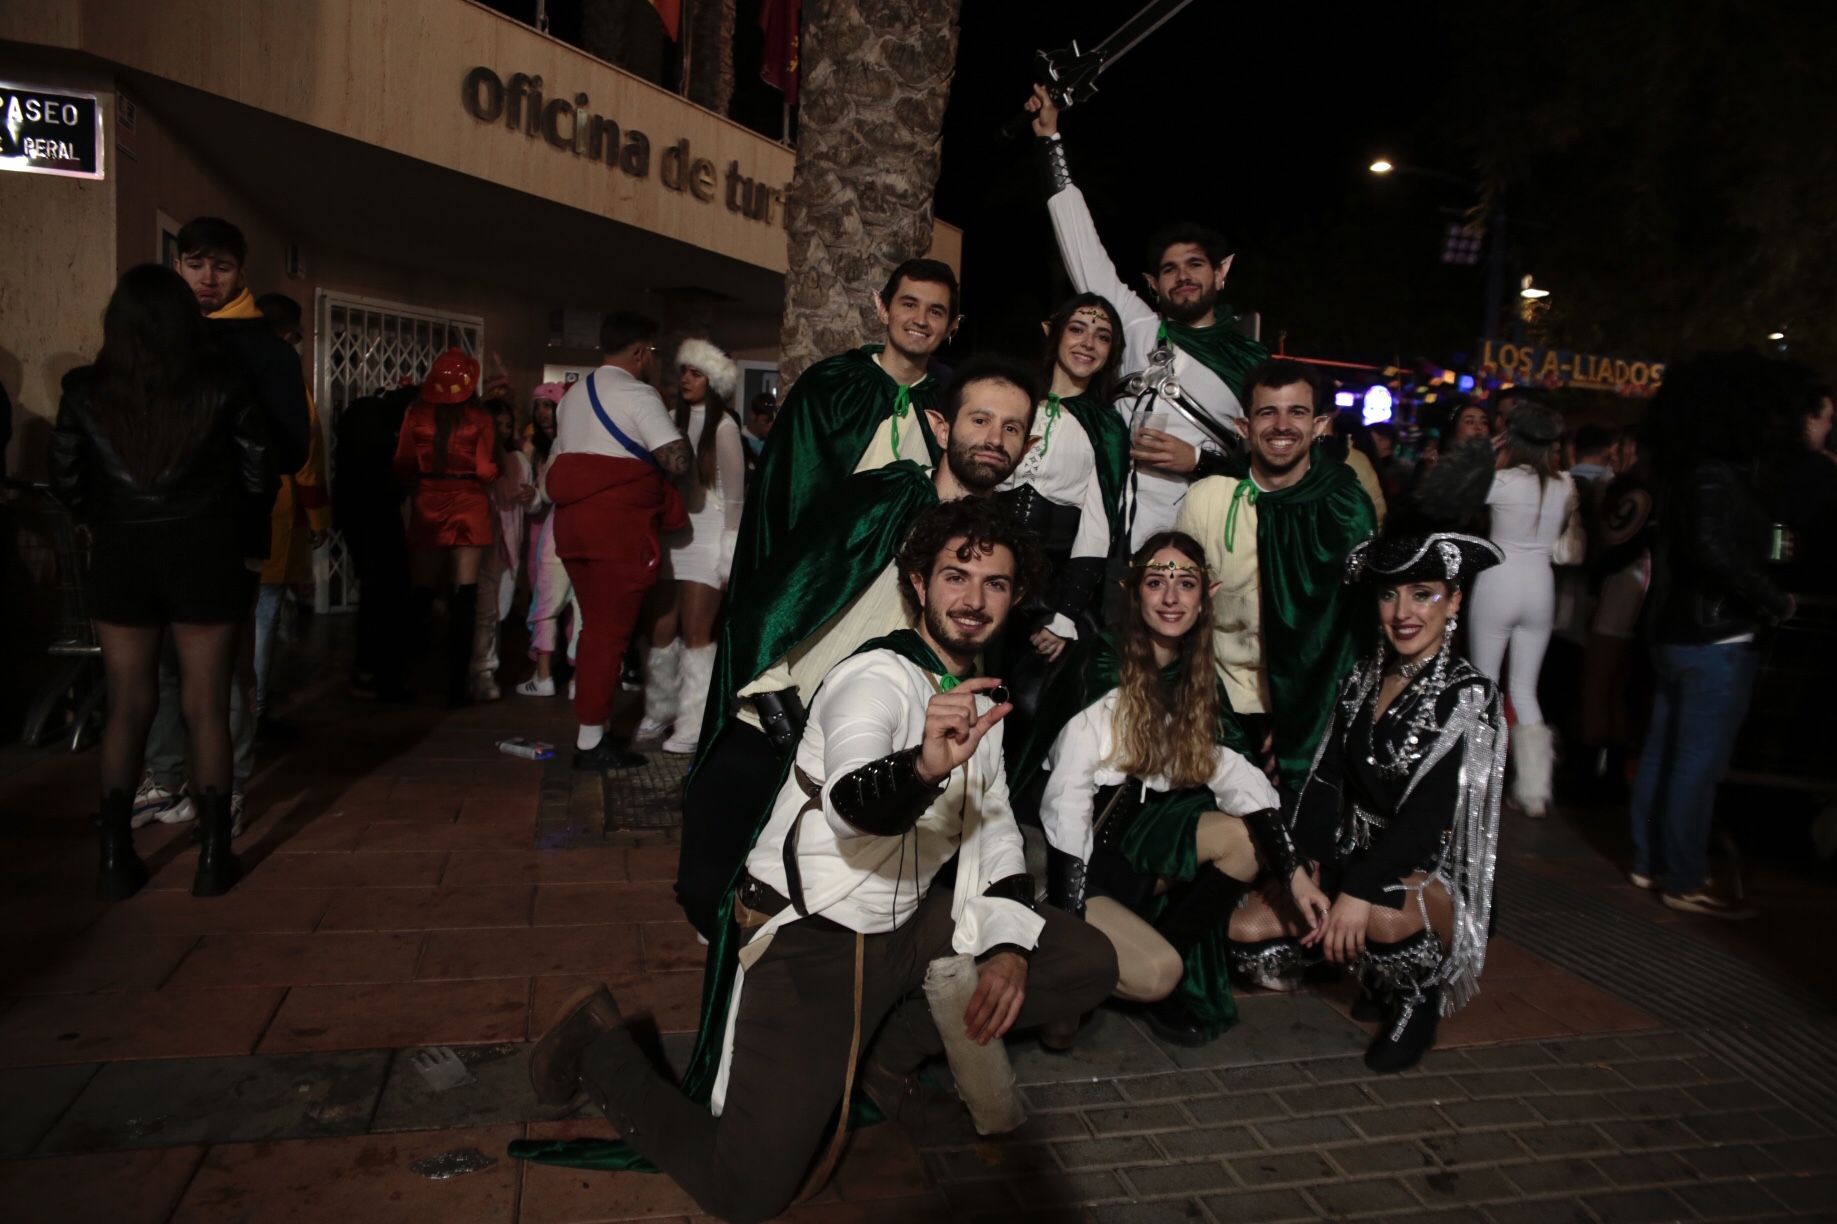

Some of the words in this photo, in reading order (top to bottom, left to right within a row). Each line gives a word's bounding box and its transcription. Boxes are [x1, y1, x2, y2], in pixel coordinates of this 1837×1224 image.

[23, 136, 81, 161] PERAL
[463, 66, 650, 178] oficina
[660, 138, 717, 203] de
[1483, 340, 1534, 377] LOS
[1540, 349, 1666, 390] A-LIADOS
